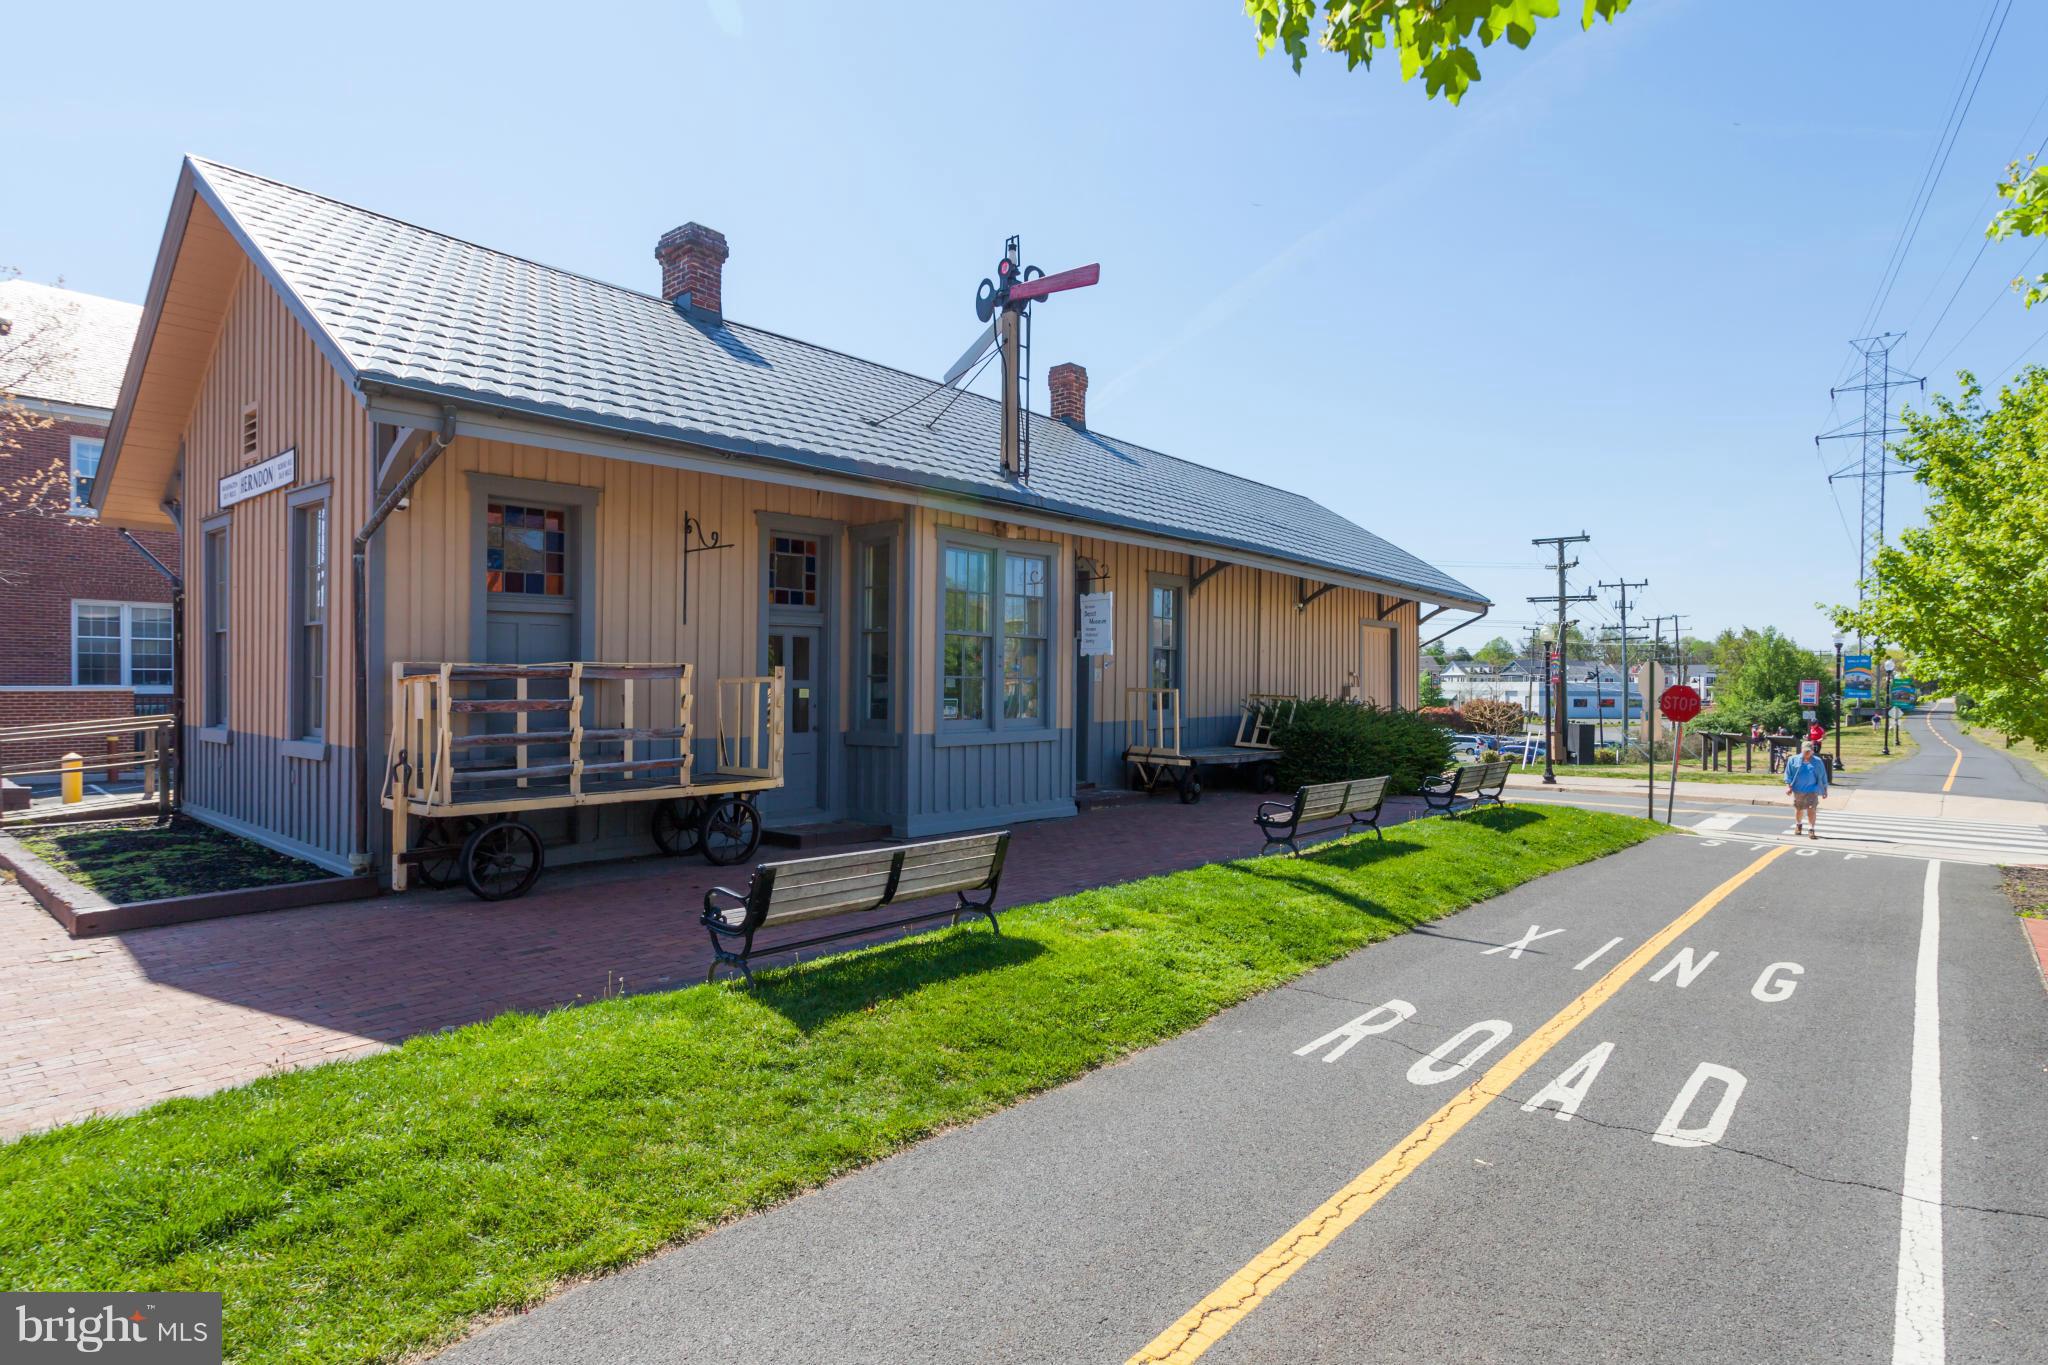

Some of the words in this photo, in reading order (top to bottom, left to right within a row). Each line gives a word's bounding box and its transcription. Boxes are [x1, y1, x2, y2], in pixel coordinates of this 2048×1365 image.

[240, 465, 274, 494] HERNDON
[1663, 695, 1698, 711] STOP
[1700, 839, 1869, 861] STOP
[1480, 925, 1805, 1002] XING
[1292, 999, 1748, 1148] ROAD
